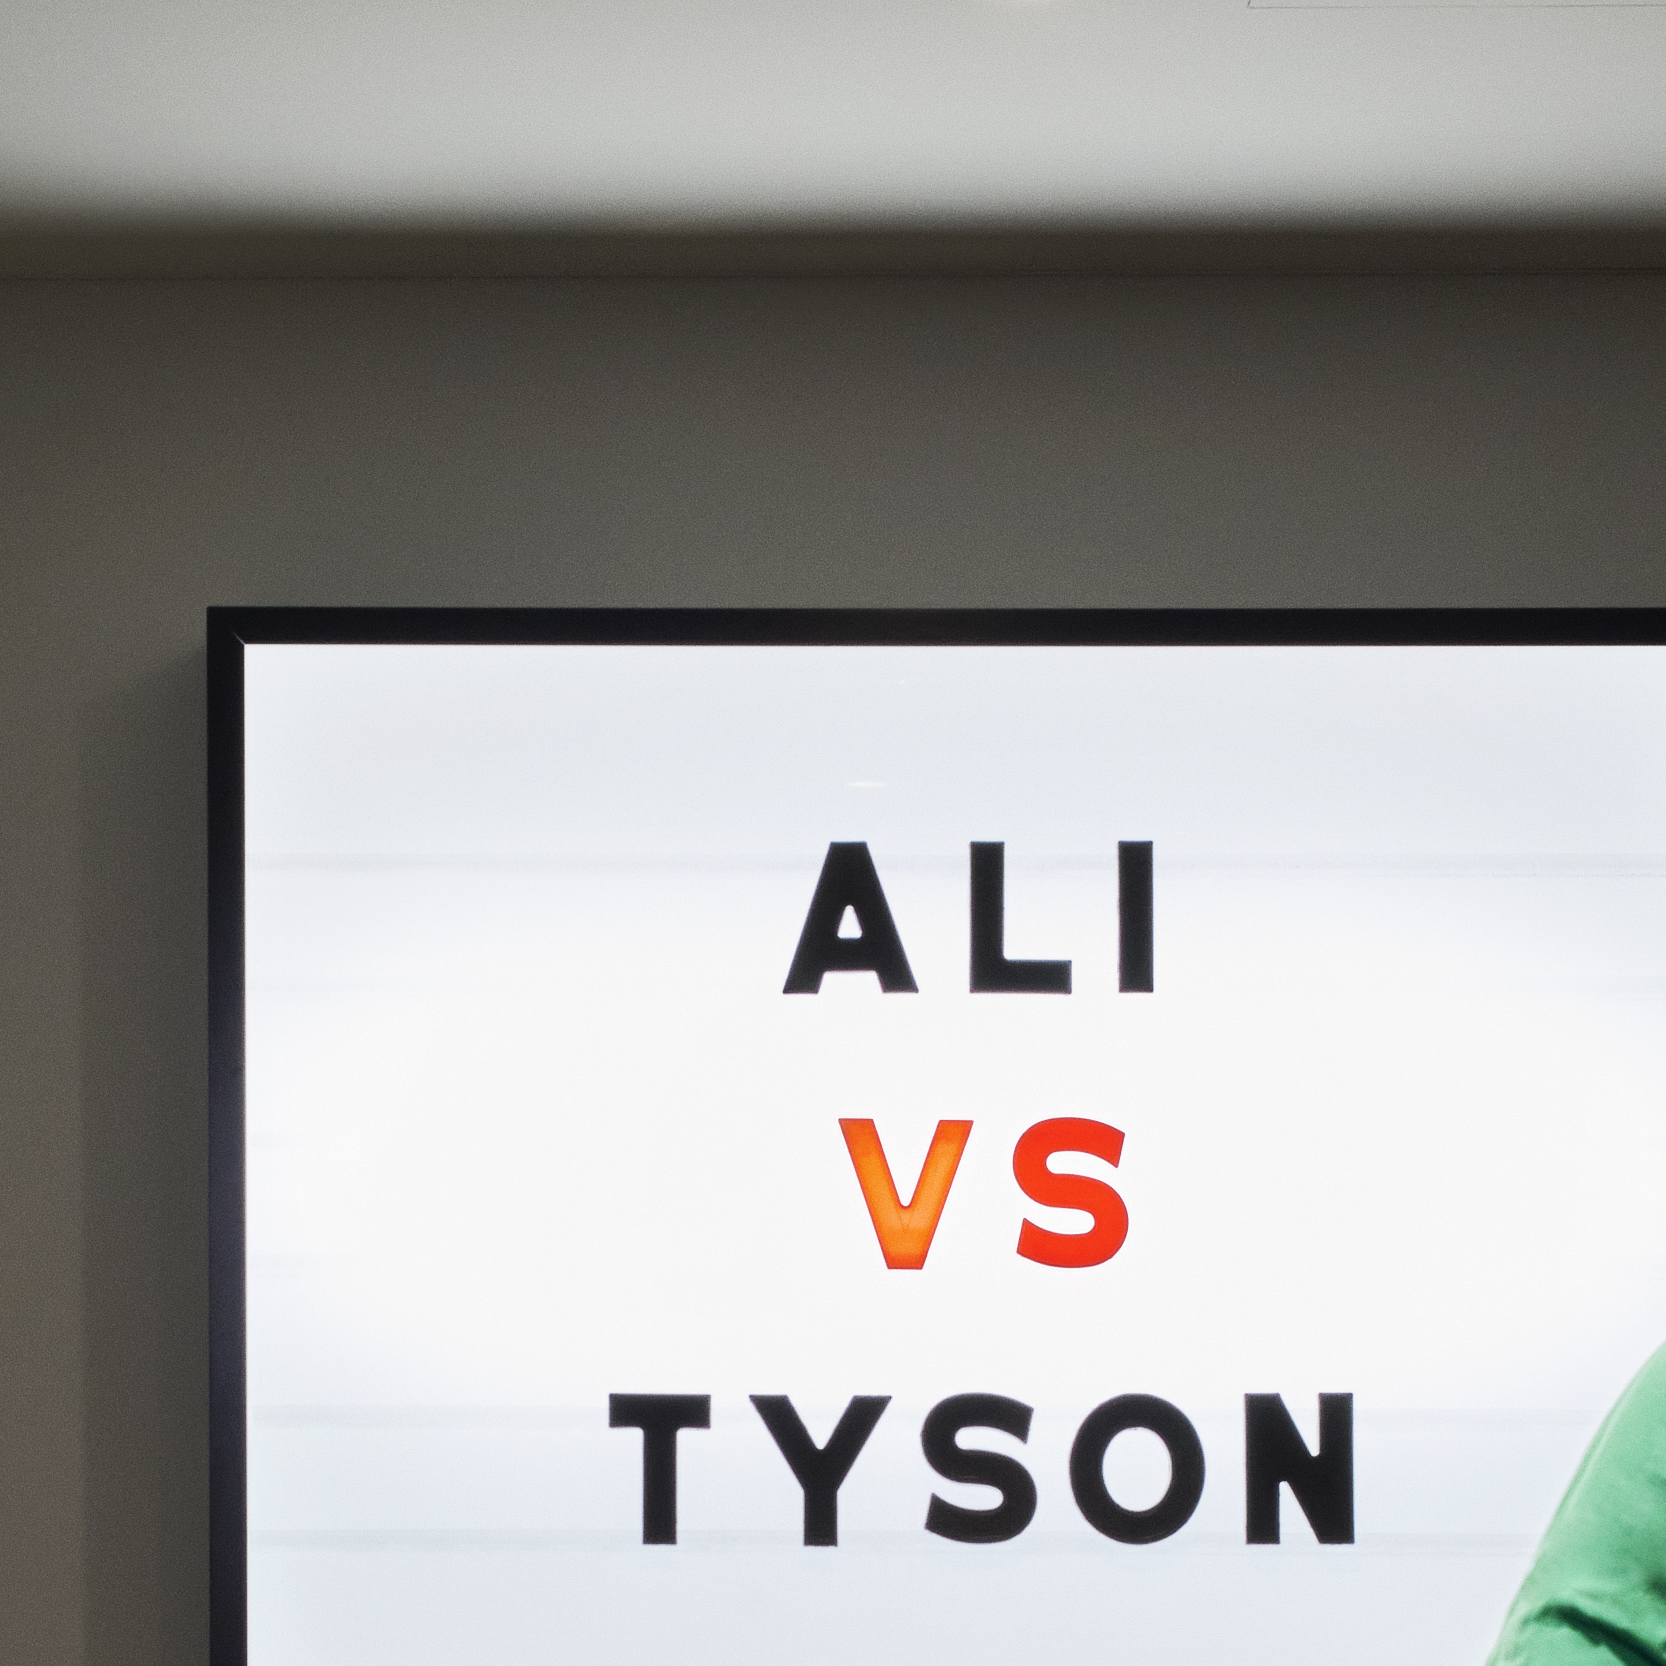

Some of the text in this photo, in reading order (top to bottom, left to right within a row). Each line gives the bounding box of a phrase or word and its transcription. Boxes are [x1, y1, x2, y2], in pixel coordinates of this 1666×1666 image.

[782, 840, 1155, 995] ALI
[837, 1116, 1130, 1271] VS
[608, 1392, 1356, 1547] TYSON
